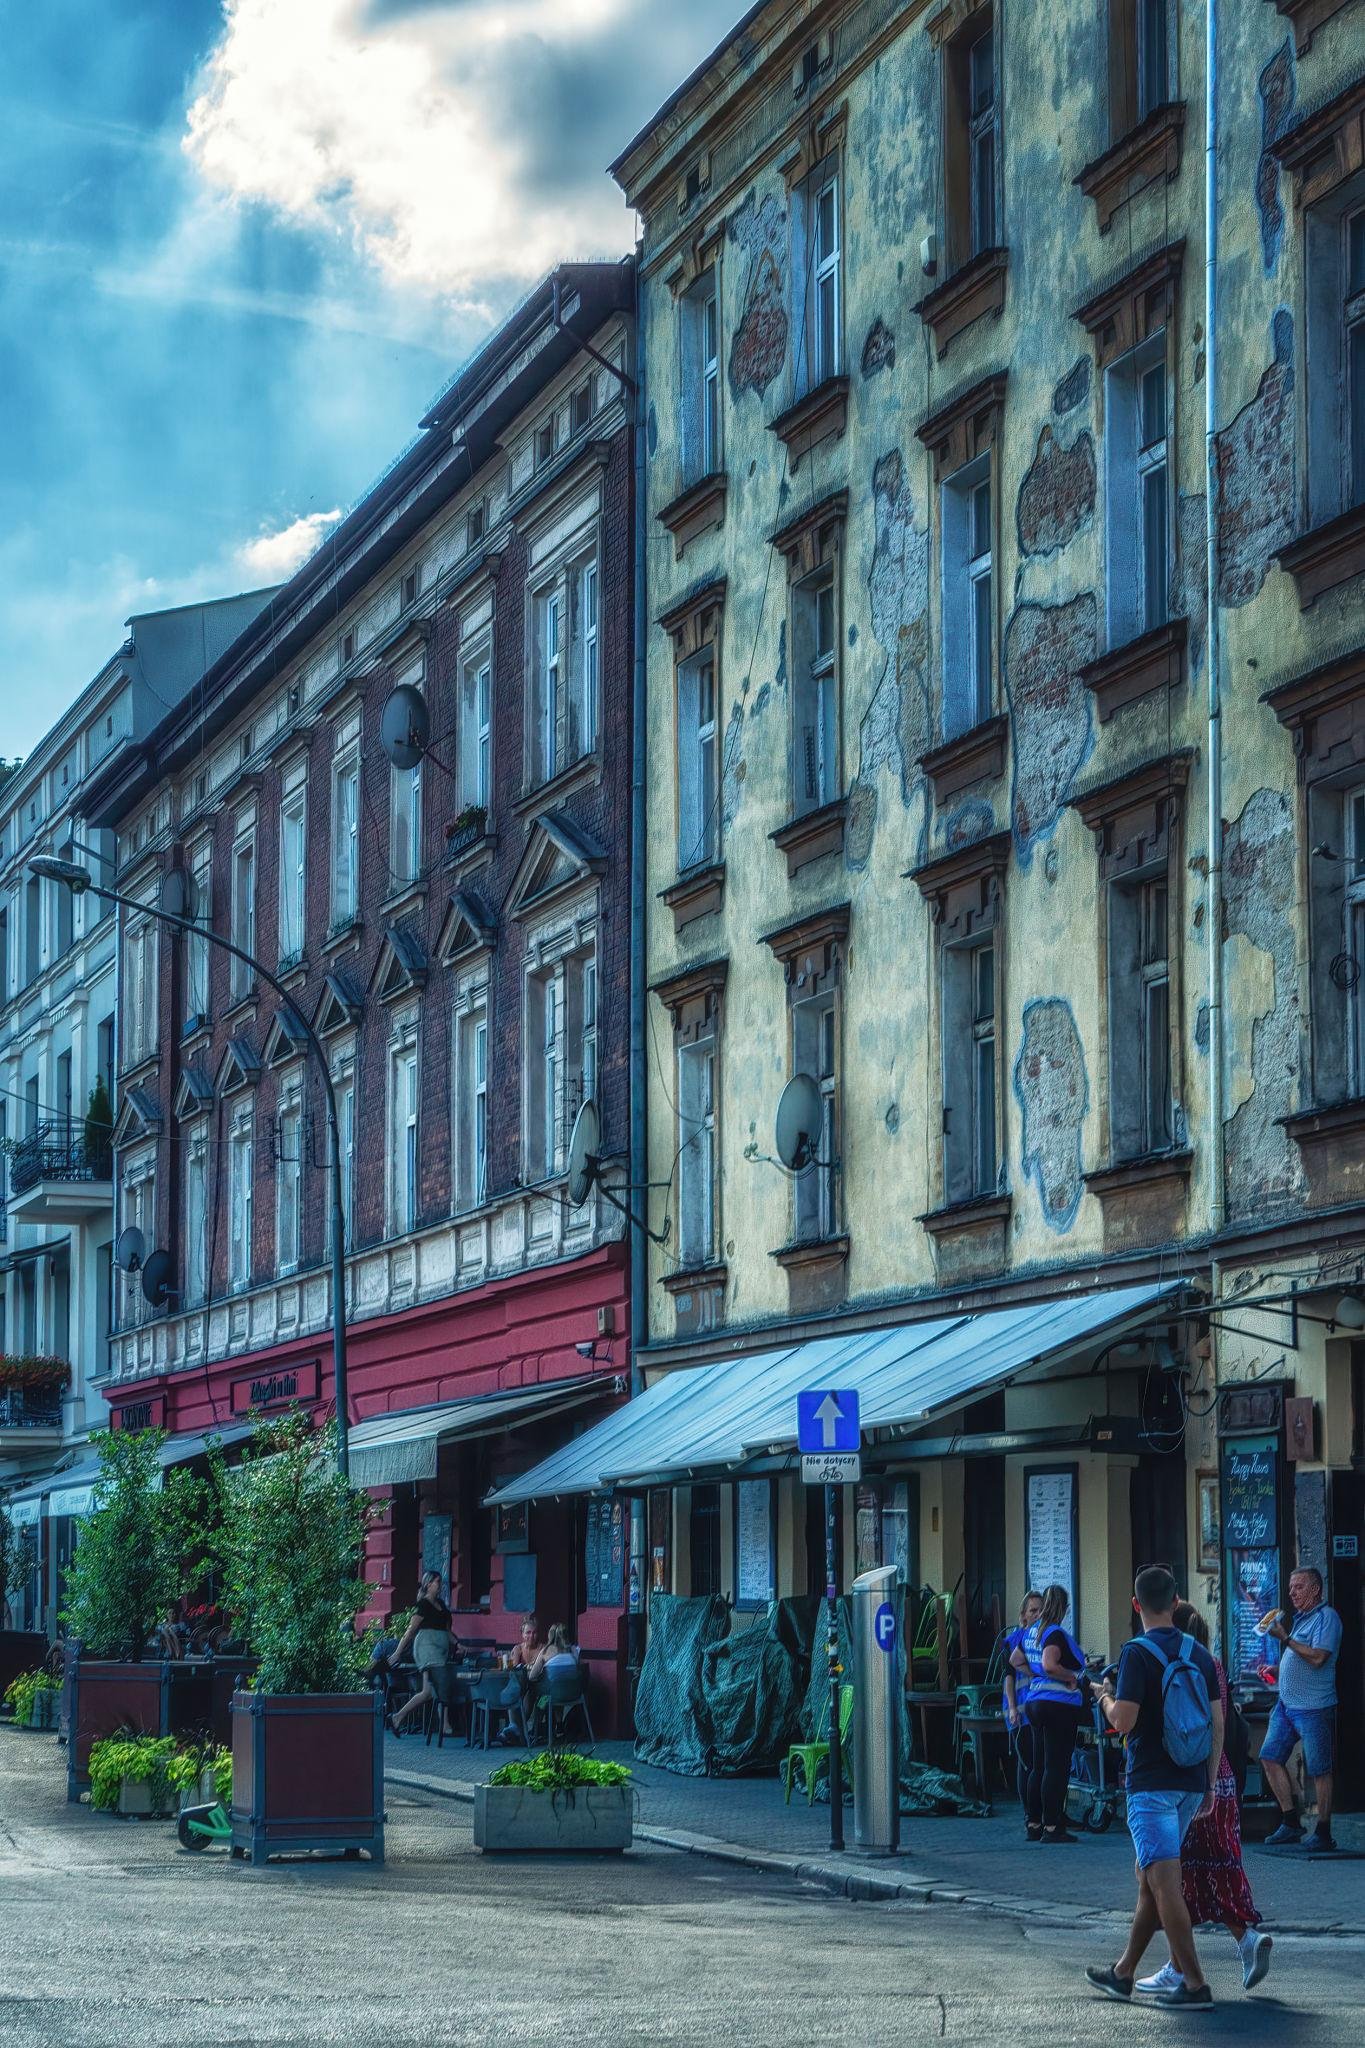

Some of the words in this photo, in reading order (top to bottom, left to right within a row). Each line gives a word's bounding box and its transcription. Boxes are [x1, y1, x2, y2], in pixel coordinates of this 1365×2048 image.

[806, 1456, 820, 1466] Nie
[824, 1456, 856, 1467] dotyczy
[880, 1615, 895, 1640] P
